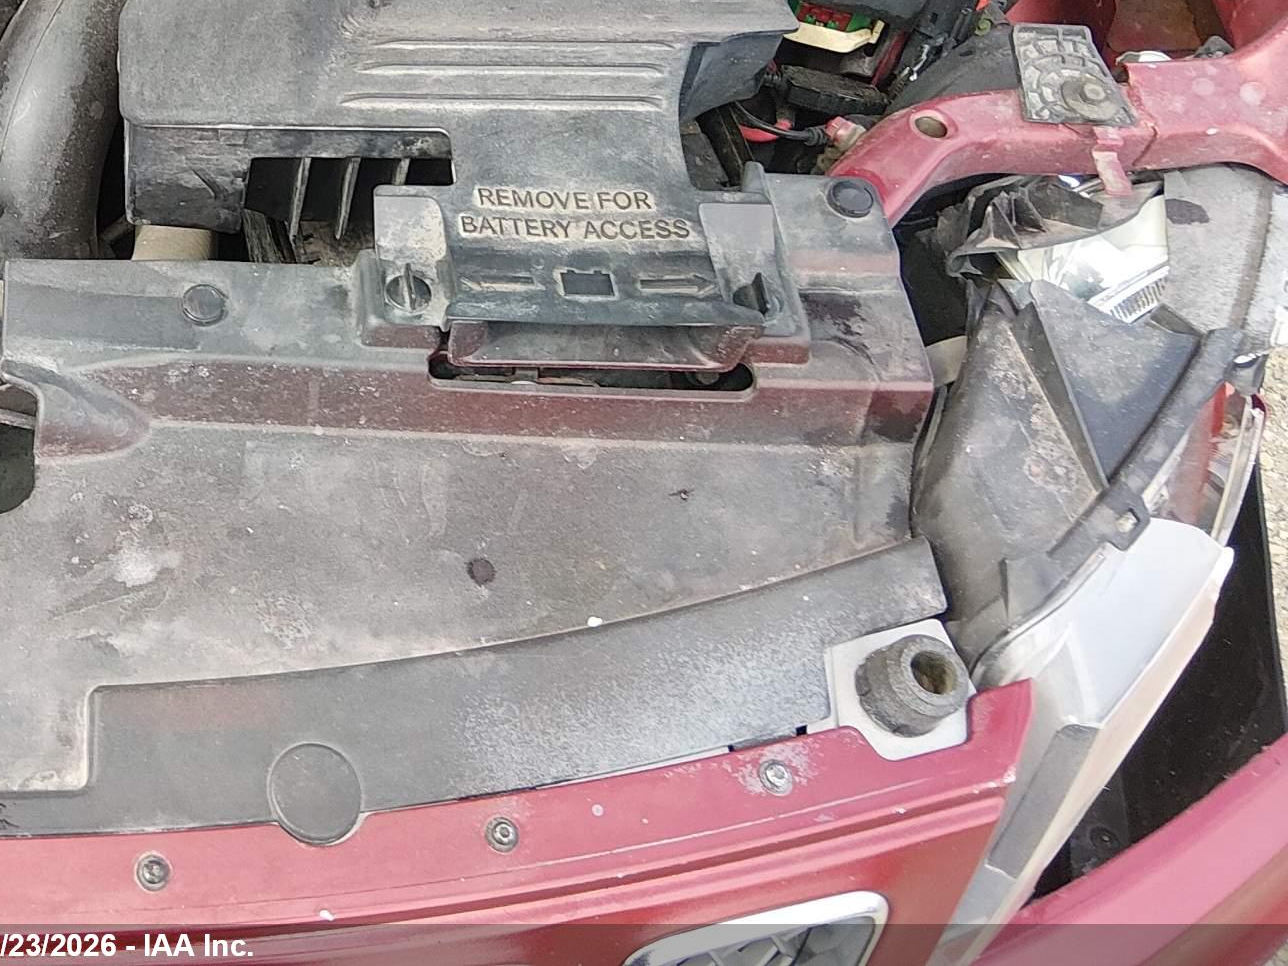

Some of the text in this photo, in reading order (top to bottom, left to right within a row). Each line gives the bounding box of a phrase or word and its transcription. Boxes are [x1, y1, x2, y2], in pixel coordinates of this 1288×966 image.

[477, 187, 653, 210] REMOVE FOR
[460, 215, 691, 240] BATTERY ACCESS
